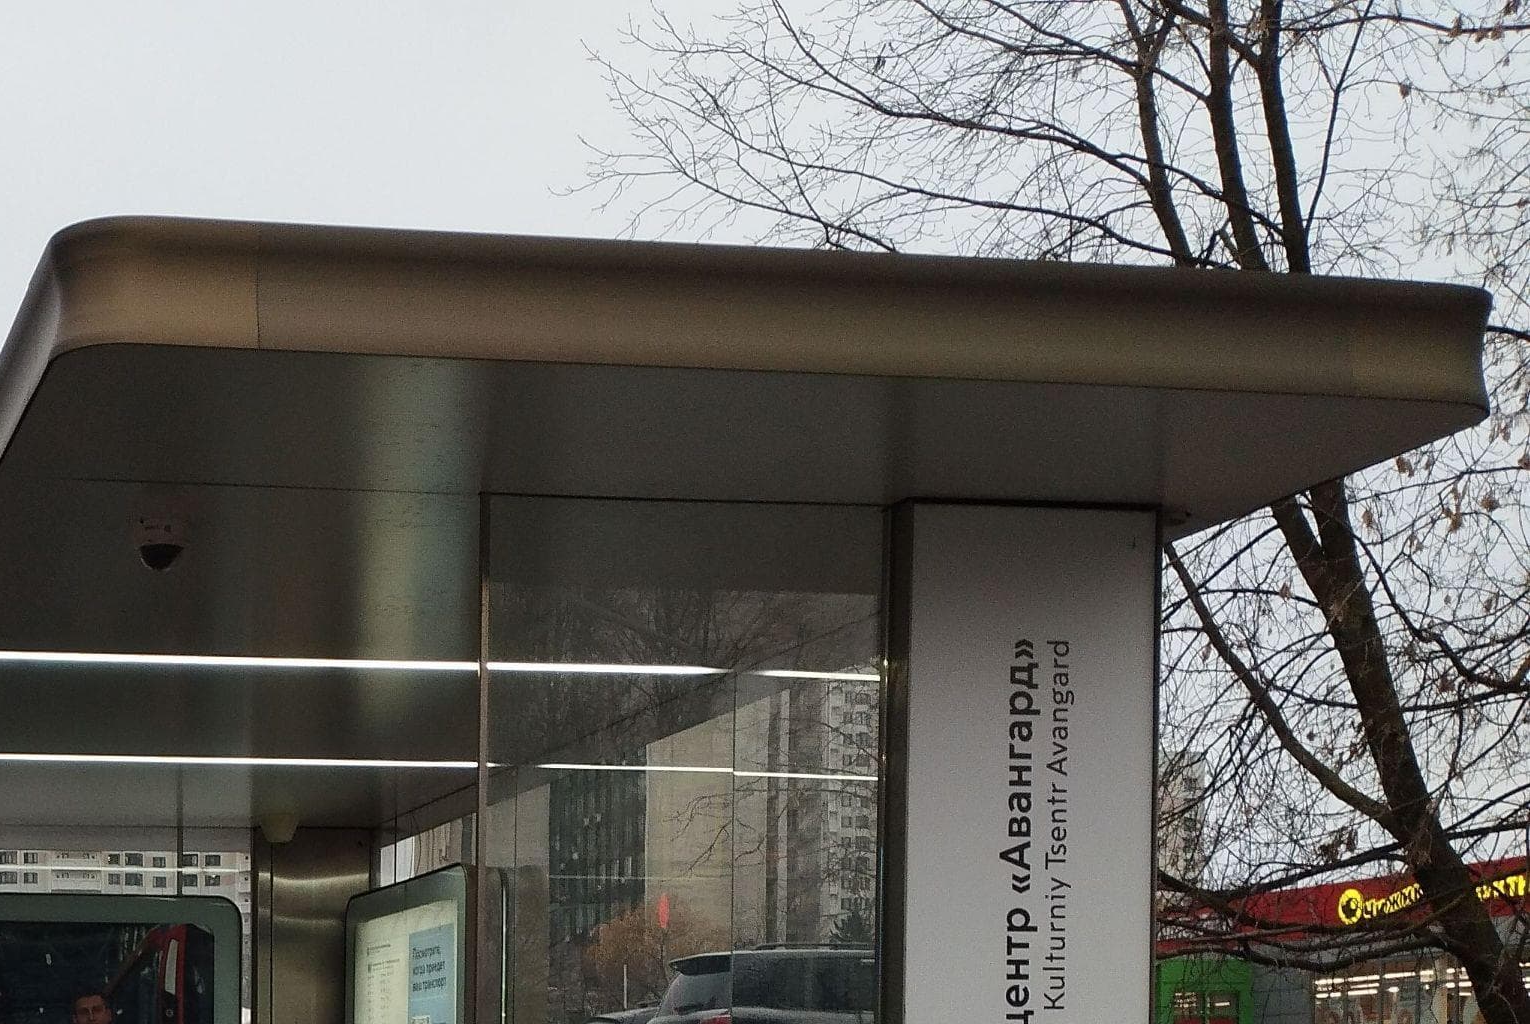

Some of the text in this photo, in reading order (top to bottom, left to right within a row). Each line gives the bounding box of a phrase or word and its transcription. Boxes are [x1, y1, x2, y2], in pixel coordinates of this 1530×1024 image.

[998, 637, 1037, 895] «Авангард»
[1043, 640, 1074, 1011] Kulturniy Tsentr Avangard
